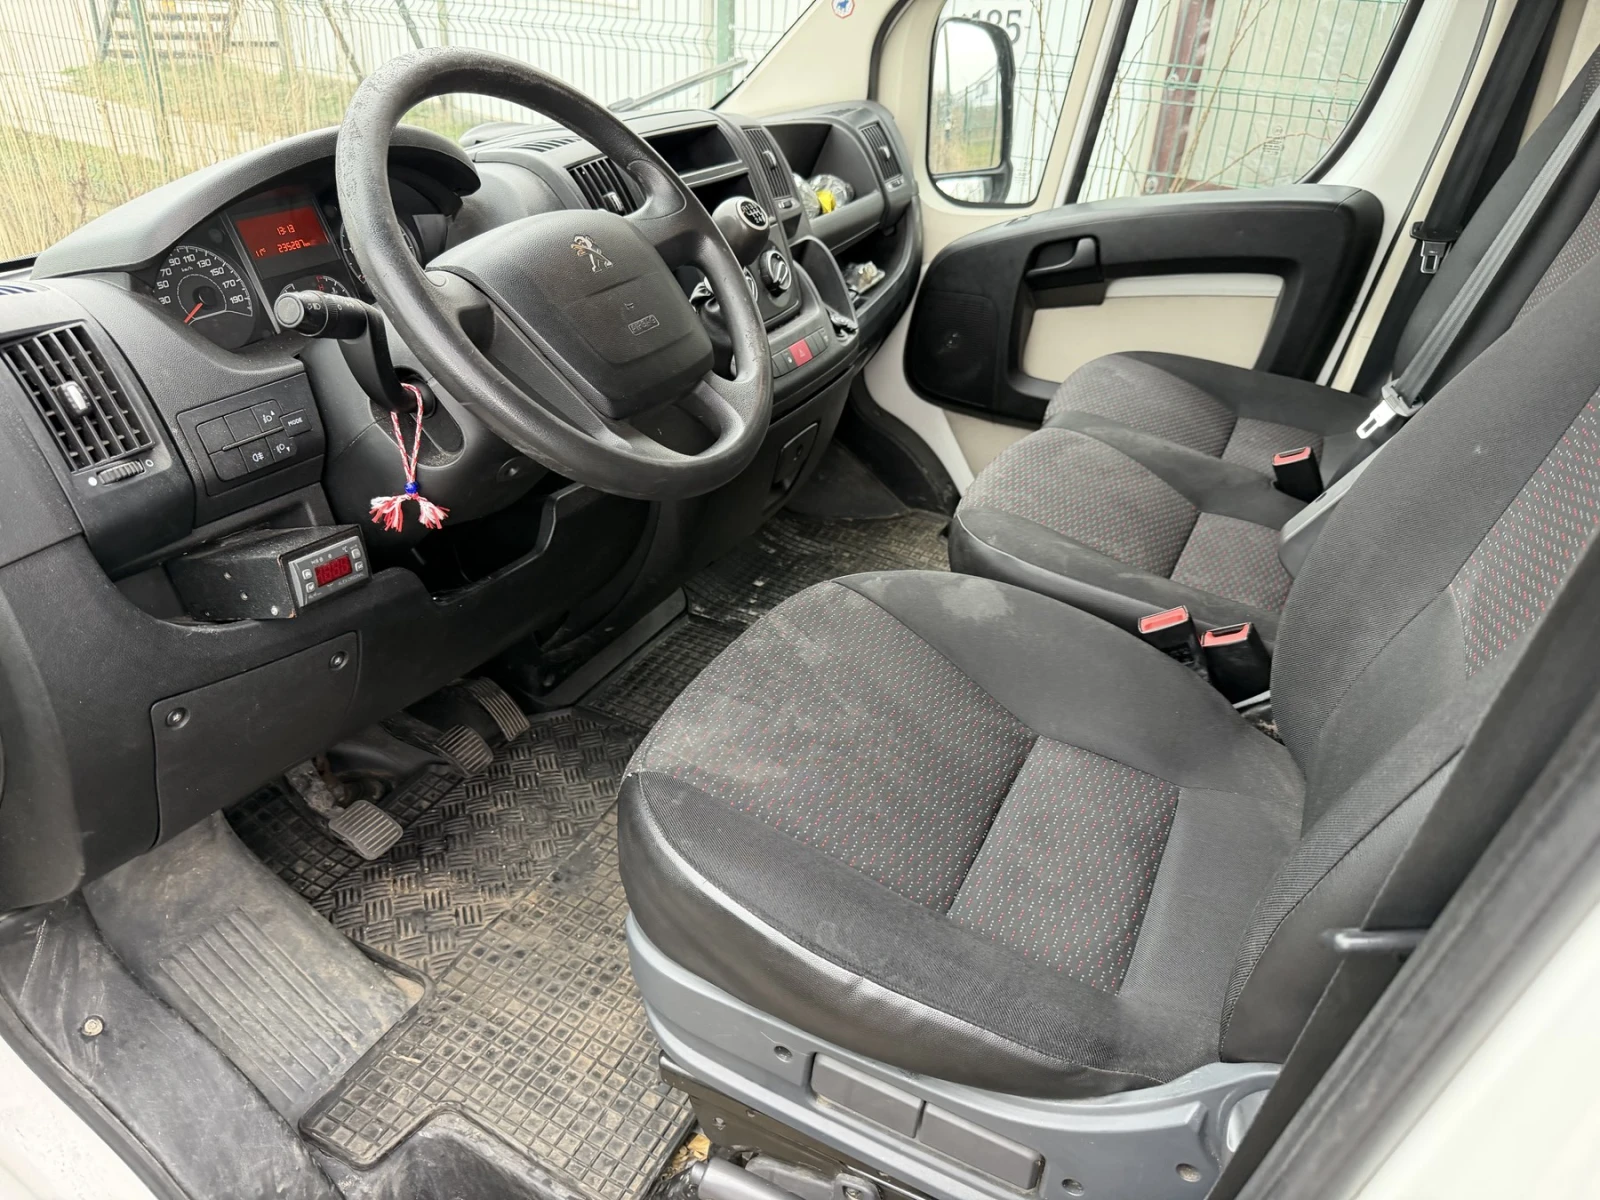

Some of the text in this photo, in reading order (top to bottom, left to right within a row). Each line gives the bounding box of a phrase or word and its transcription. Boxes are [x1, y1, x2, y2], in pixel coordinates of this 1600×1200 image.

[277, 239, 305, 253] 235287
[168, 257, 181, 267] 90
[182, 253, 196, 264] 110
[196, 258, 212, 268] 130
[160, 267, 172, 277] 70
[209, 267, 225, 276] 150
[156, 280, 169, 290] 50
[222, 279, 236, 289] 170
[158, 295, 171, 305] 30
[229, 294, 244, 304] 190
[287, 417, 303, 427] MODE
